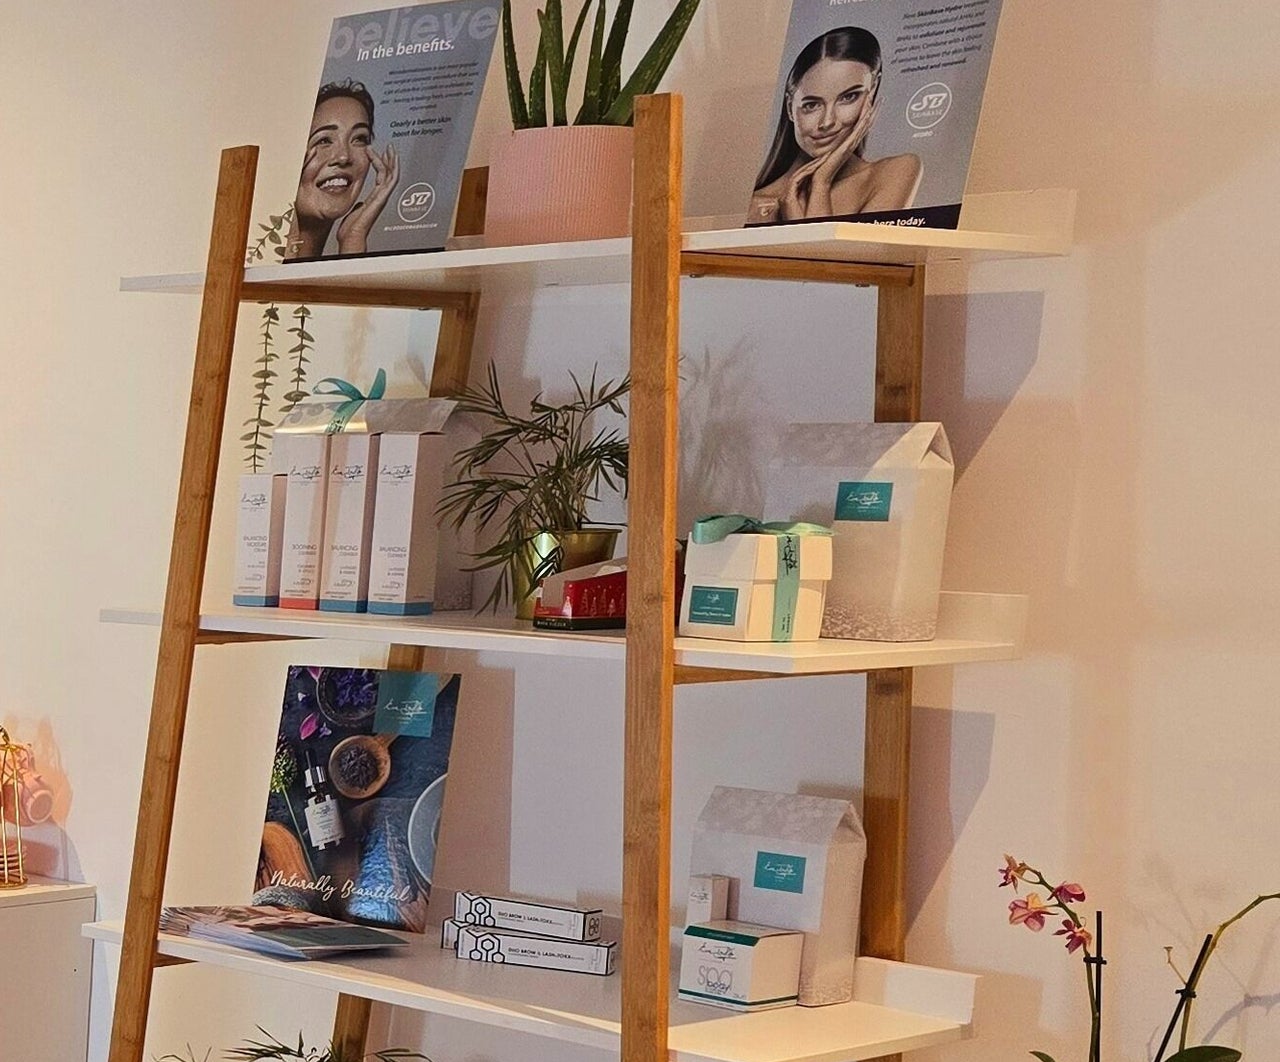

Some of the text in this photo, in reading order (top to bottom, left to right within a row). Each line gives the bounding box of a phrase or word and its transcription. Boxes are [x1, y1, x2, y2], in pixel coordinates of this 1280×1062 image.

[356, 37, 455, 61] In the benefits.
[897, 216, 927, 227] today.
[271, 870, 411, 902] Naturally Beautiful
